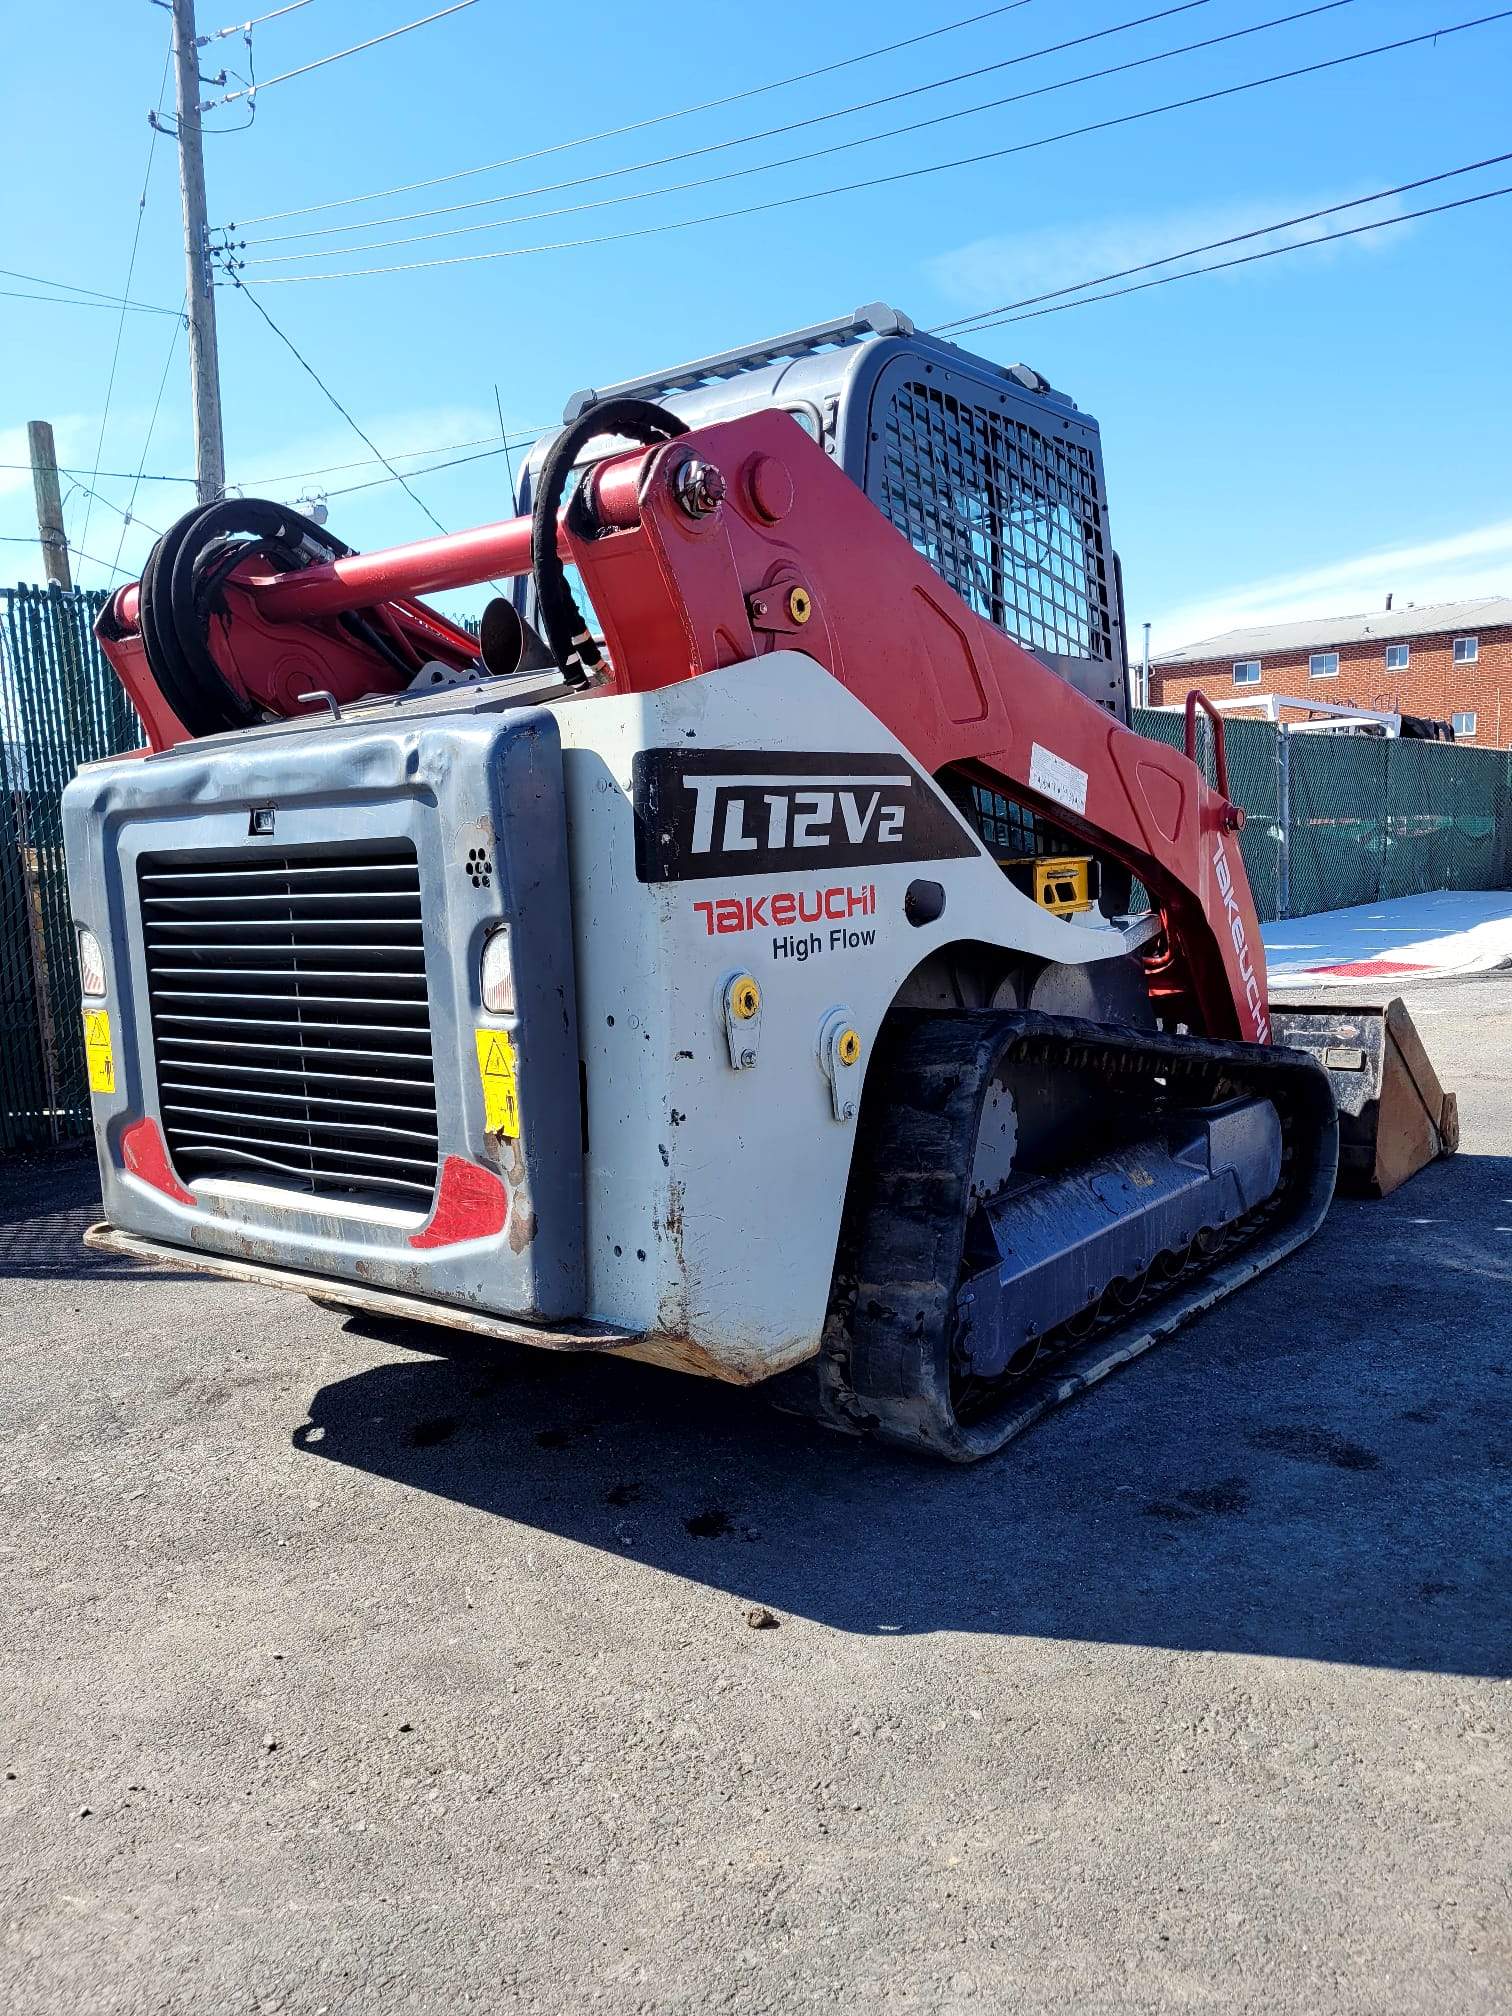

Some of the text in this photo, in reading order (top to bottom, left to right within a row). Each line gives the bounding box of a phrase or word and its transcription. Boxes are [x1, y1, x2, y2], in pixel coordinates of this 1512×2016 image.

[683, 774, 912, 854] TL12V2
[772, 928, 877, 961] High Flow
